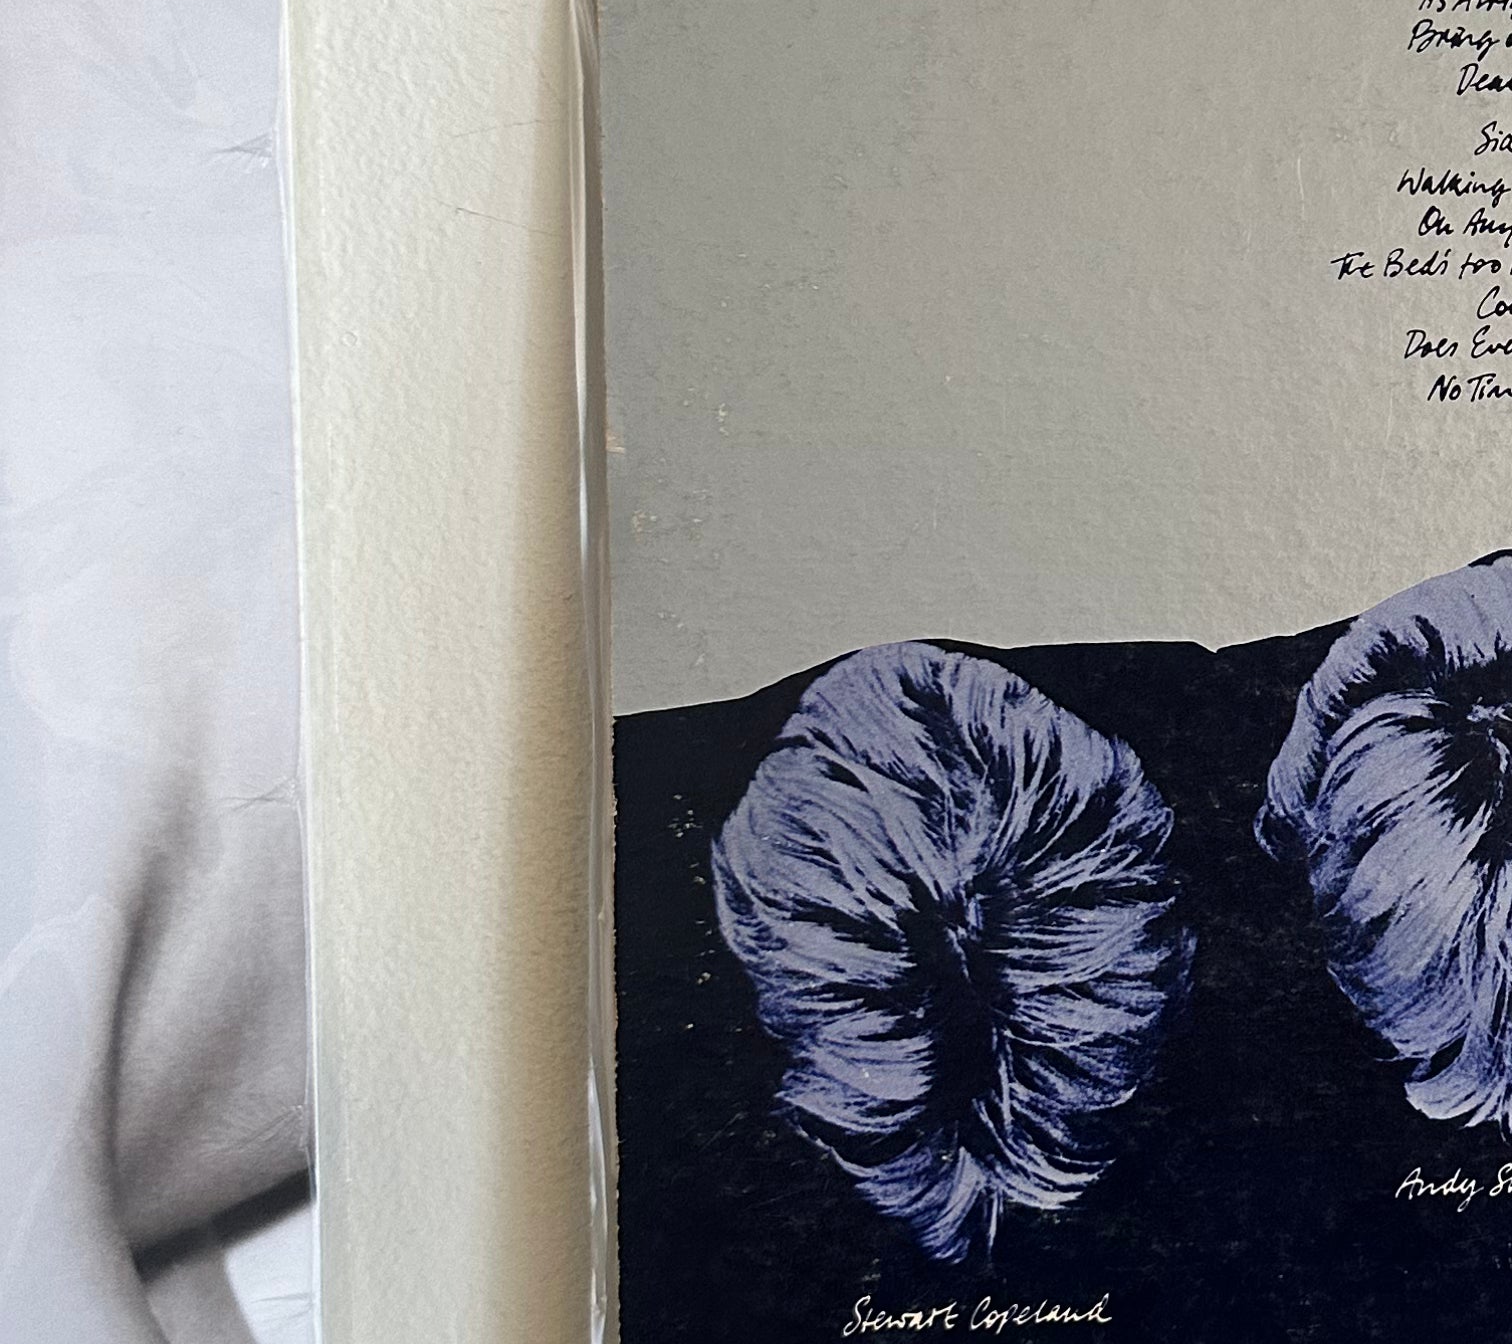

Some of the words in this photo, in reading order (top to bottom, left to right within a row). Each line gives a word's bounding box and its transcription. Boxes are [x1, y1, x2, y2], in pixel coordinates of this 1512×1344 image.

[1407, 18, 1500, 61] Bring
[1397, 167, 1511, 206] Walking
[1418, 206, 1454, 237] On
[1403, 328, 1459, 359] Does
[1427, 373, 1462, 403] No
[1395, 1167, 1485, 1213] Andy
[841, 1295, 959, 1337] Stewart
[969, 1292, 1113, 1336] Copeland
